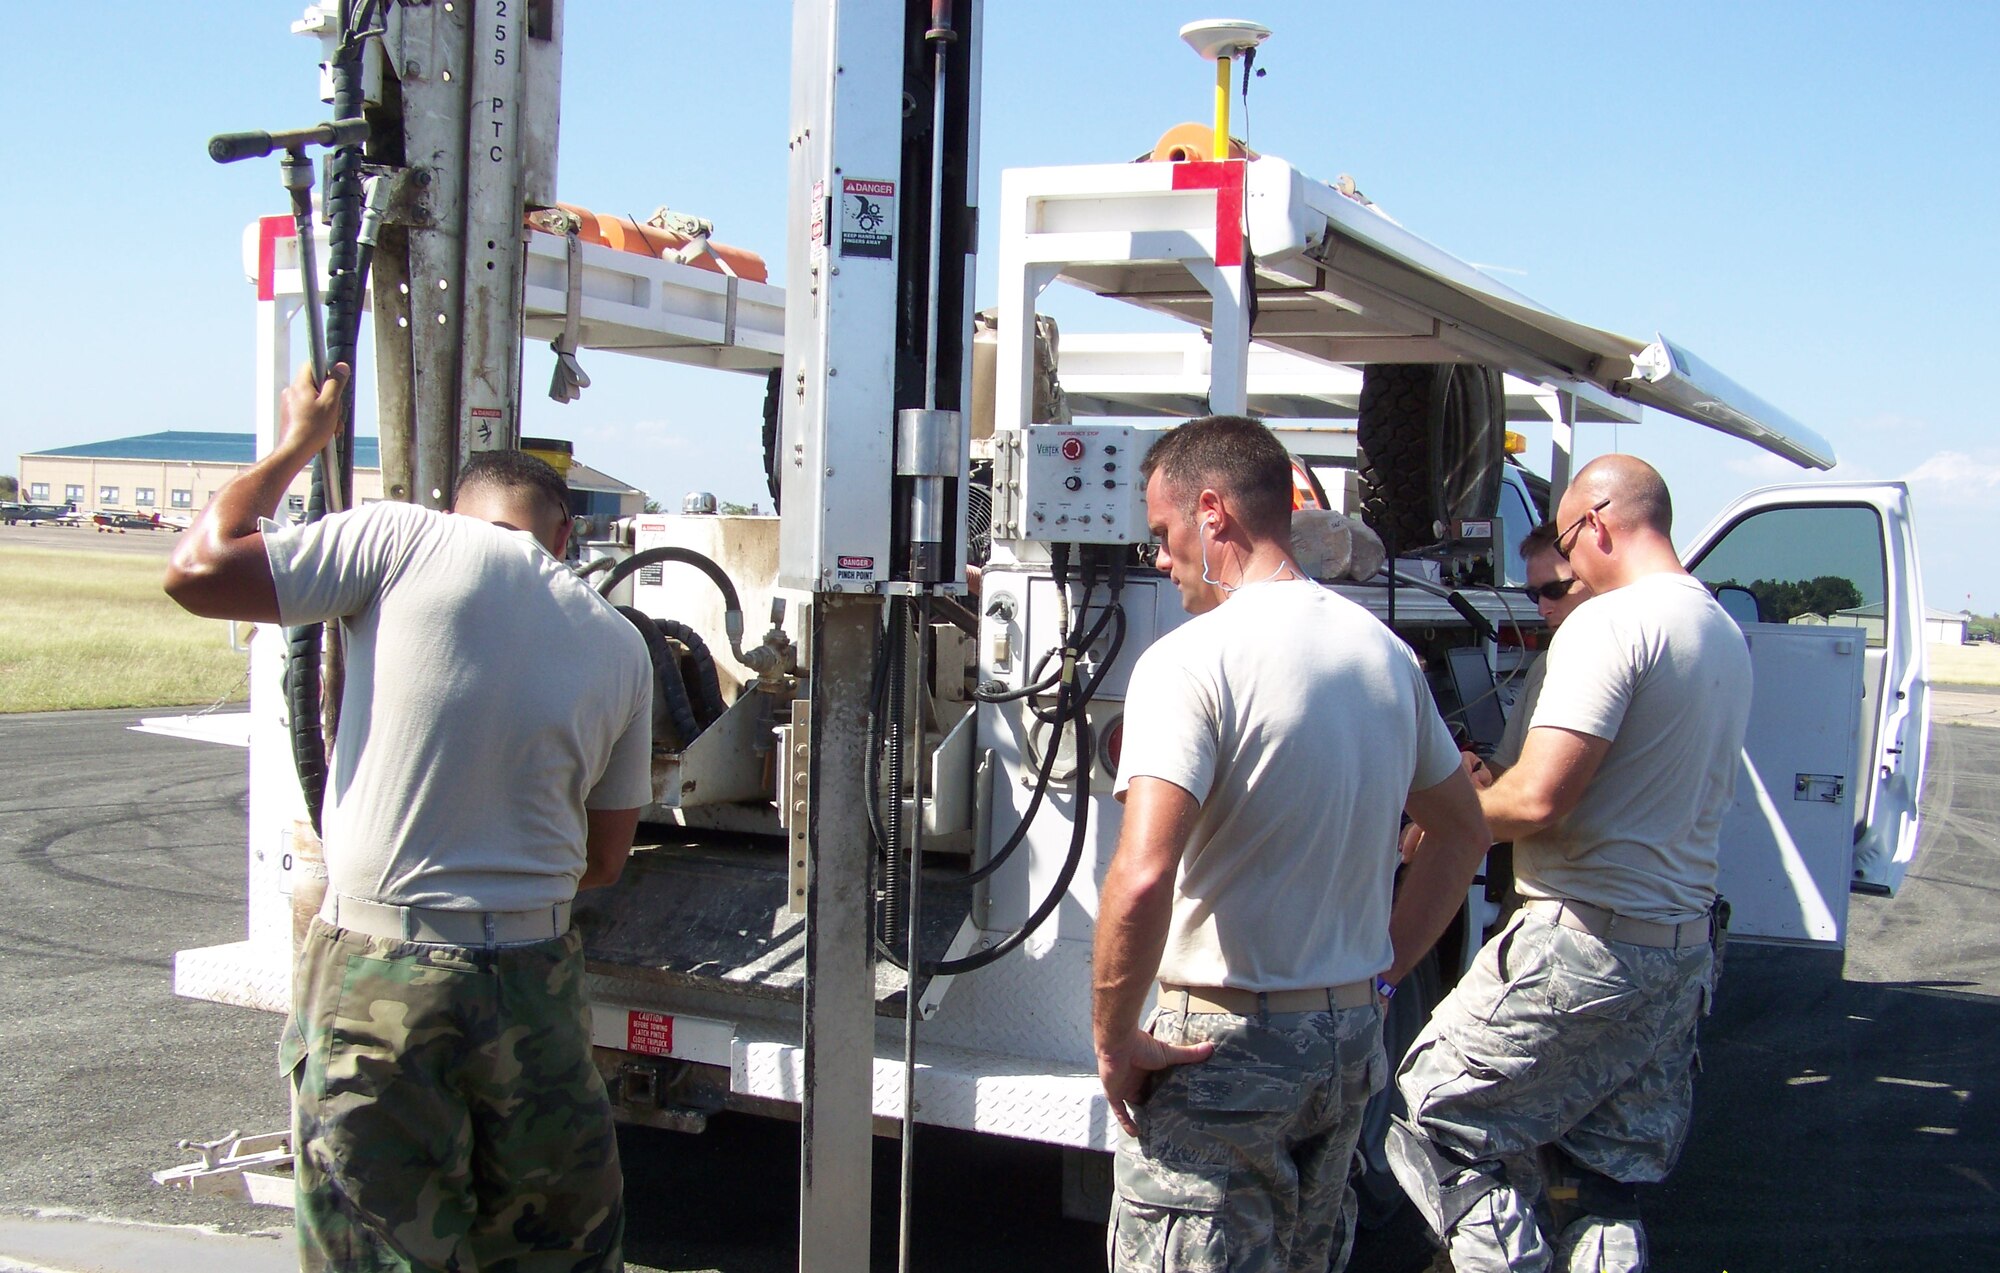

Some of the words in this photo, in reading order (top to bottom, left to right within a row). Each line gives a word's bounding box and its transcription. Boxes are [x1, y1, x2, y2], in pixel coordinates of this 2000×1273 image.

[490, 97, 503, 162] PTC
[856, 184, 893, 194] DANGER
[843, 558, 868, 566] DANGER
[838, 570, 855, 579] PINCH
[856, 571, 873, 580] POINT
[638, 1012, 663, 1023] CAUTION
[633, 1020, 648, 1029] BEFORE
[650, 1022, 668, 1032] TOWING
[635, 1028, 649, 1036] LATCH
[650, 1031, 665, 1039] PINTLE
[632, 1036, 646, 1044] CLOSE
[631, 1042, 648, 1052] INSTALL
[649, 1045, 660, 1054] LOCK
